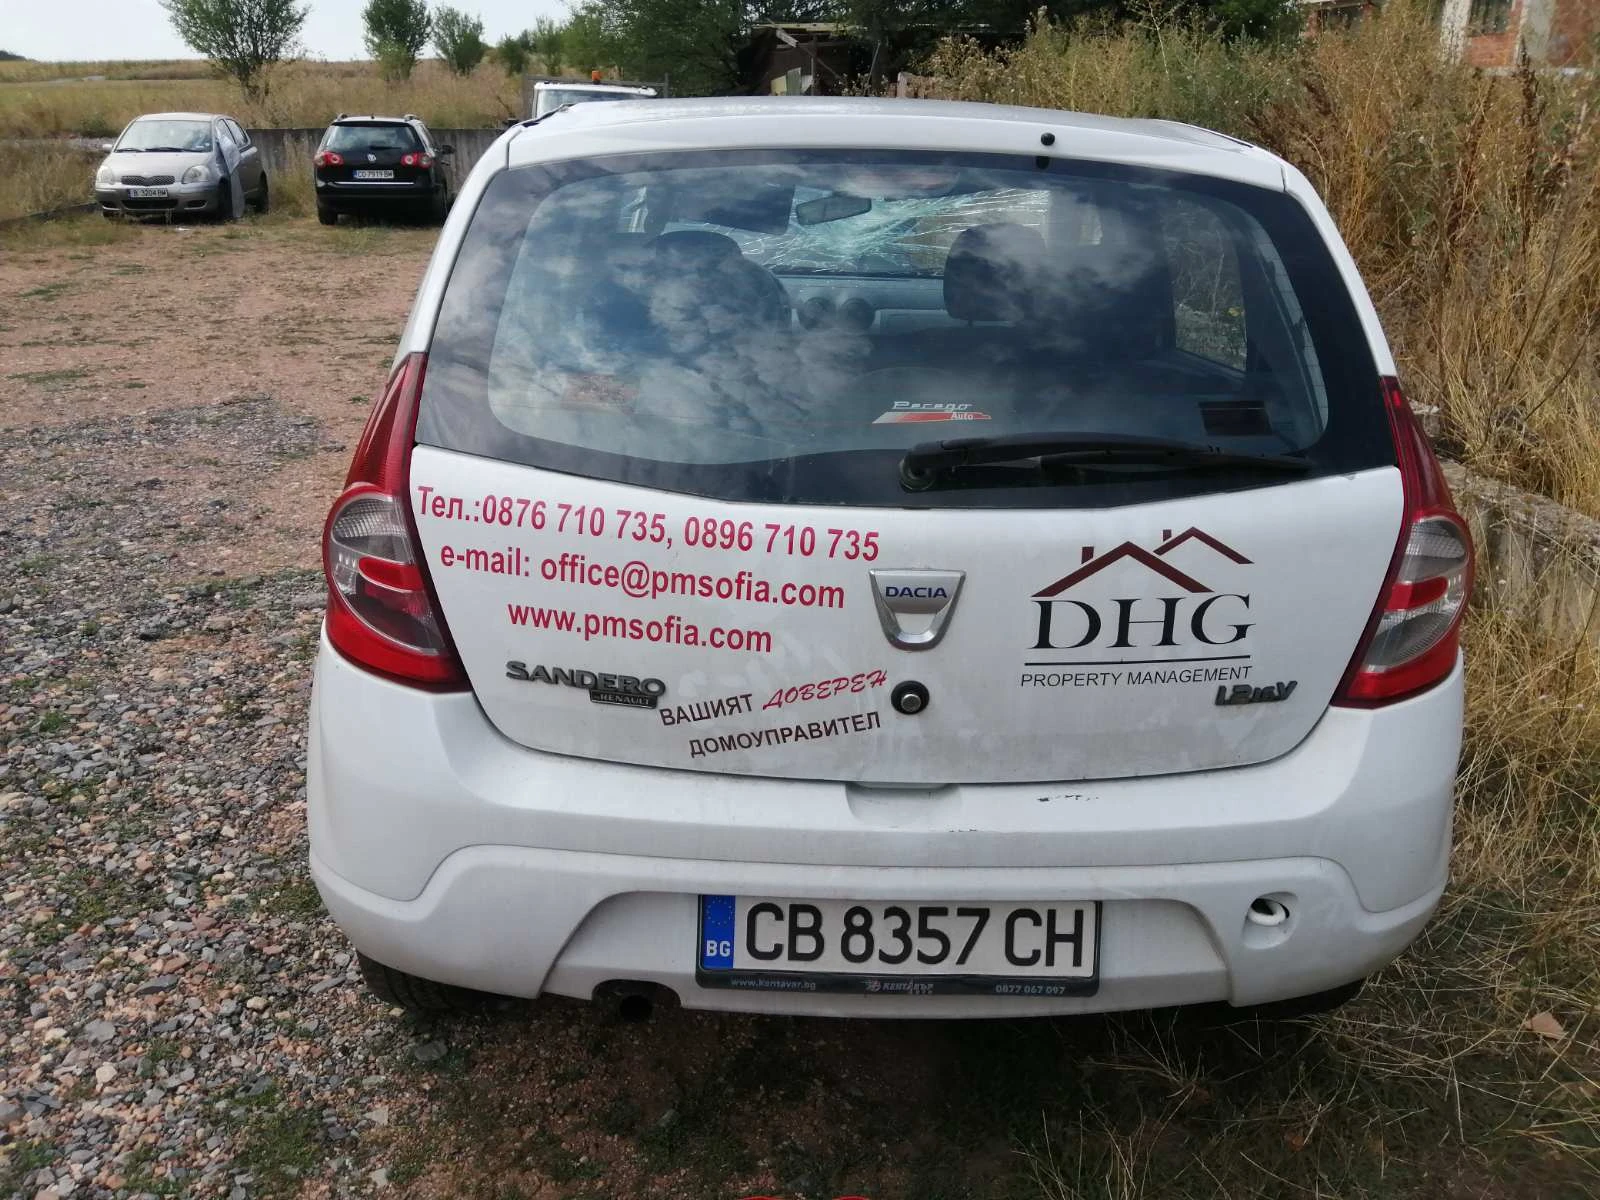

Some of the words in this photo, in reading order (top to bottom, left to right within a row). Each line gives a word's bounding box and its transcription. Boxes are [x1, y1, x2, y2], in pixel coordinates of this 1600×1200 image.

[950, 411, 974, 420] Auto
[558, 503, 605, 537] 710
[616, 510, 673, 548] 735,
[684, 516, 753, 552] 0896
[765, 523, 816, 557] 710
[828, 528, 880, 562] 735
[440, 544, 530, 577] e-mail:
[540, 552, 845, 609] office@pmsofia.com
[885, 586, 948, 598] DACIA
[507, 603, 772, 653] www.pmsofia.com
[1027, 593, 1257, 650] DHG
[506, 660, 666, 697] SANDERO
[600, 693, 650, 705] RENAULT
[659, 693, 753, 727] ВАШИЯТ
[761, 669, 888, 711] ДОВЕРЕН
[1020, 672, 1123, 688] PROPERTY
[1126, 665, 1253, 686] MANAGEMENT
[689, 711, 882, 759] ДОМОУПРАВИТЕЛ
[706, 940, 731, 957] BG
[745, 902, 825, 962] CB
[840, 905, 991, 965] 8357
[1004, 907, 1085, 968] CH
